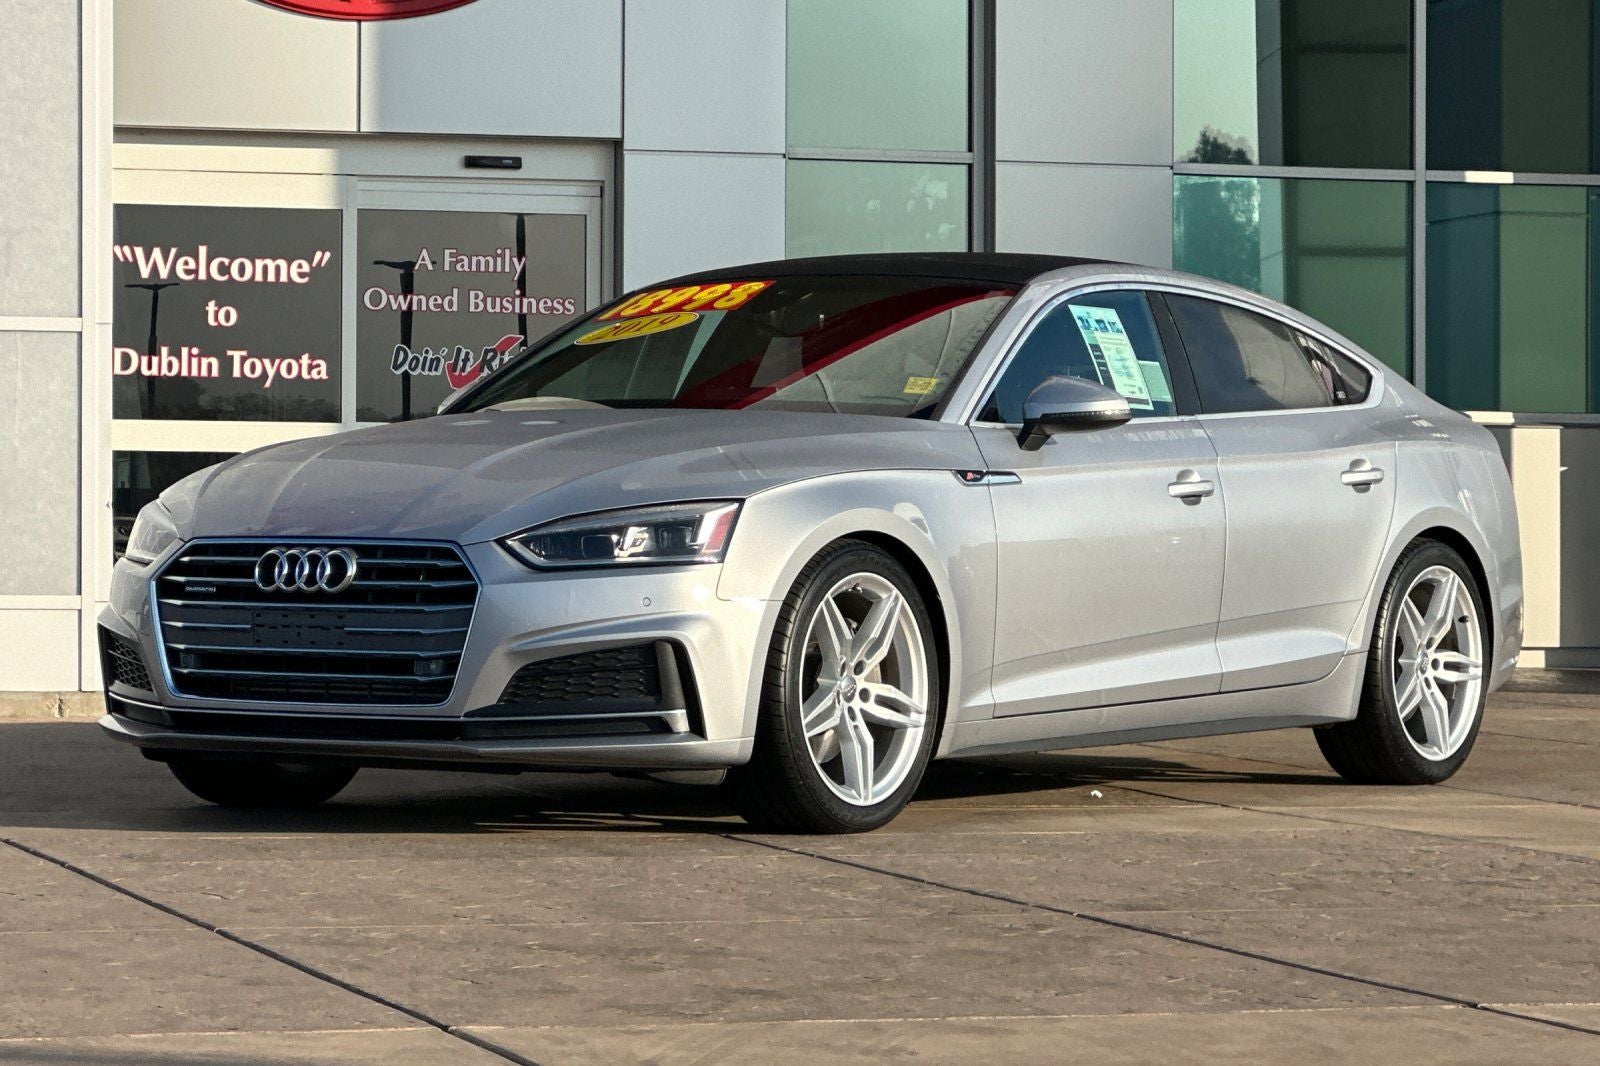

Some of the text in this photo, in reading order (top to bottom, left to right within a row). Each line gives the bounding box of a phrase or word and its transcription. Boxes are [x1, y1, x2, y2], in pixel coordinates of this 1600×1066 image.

[414, 248, 527, 281] A Family
[205, 299, 239, 327] to
[363, 286, 576, 315] Owned Business
[113, 346, 329, 389] Dublin Toyota
[452, 345, 474, 375] It
